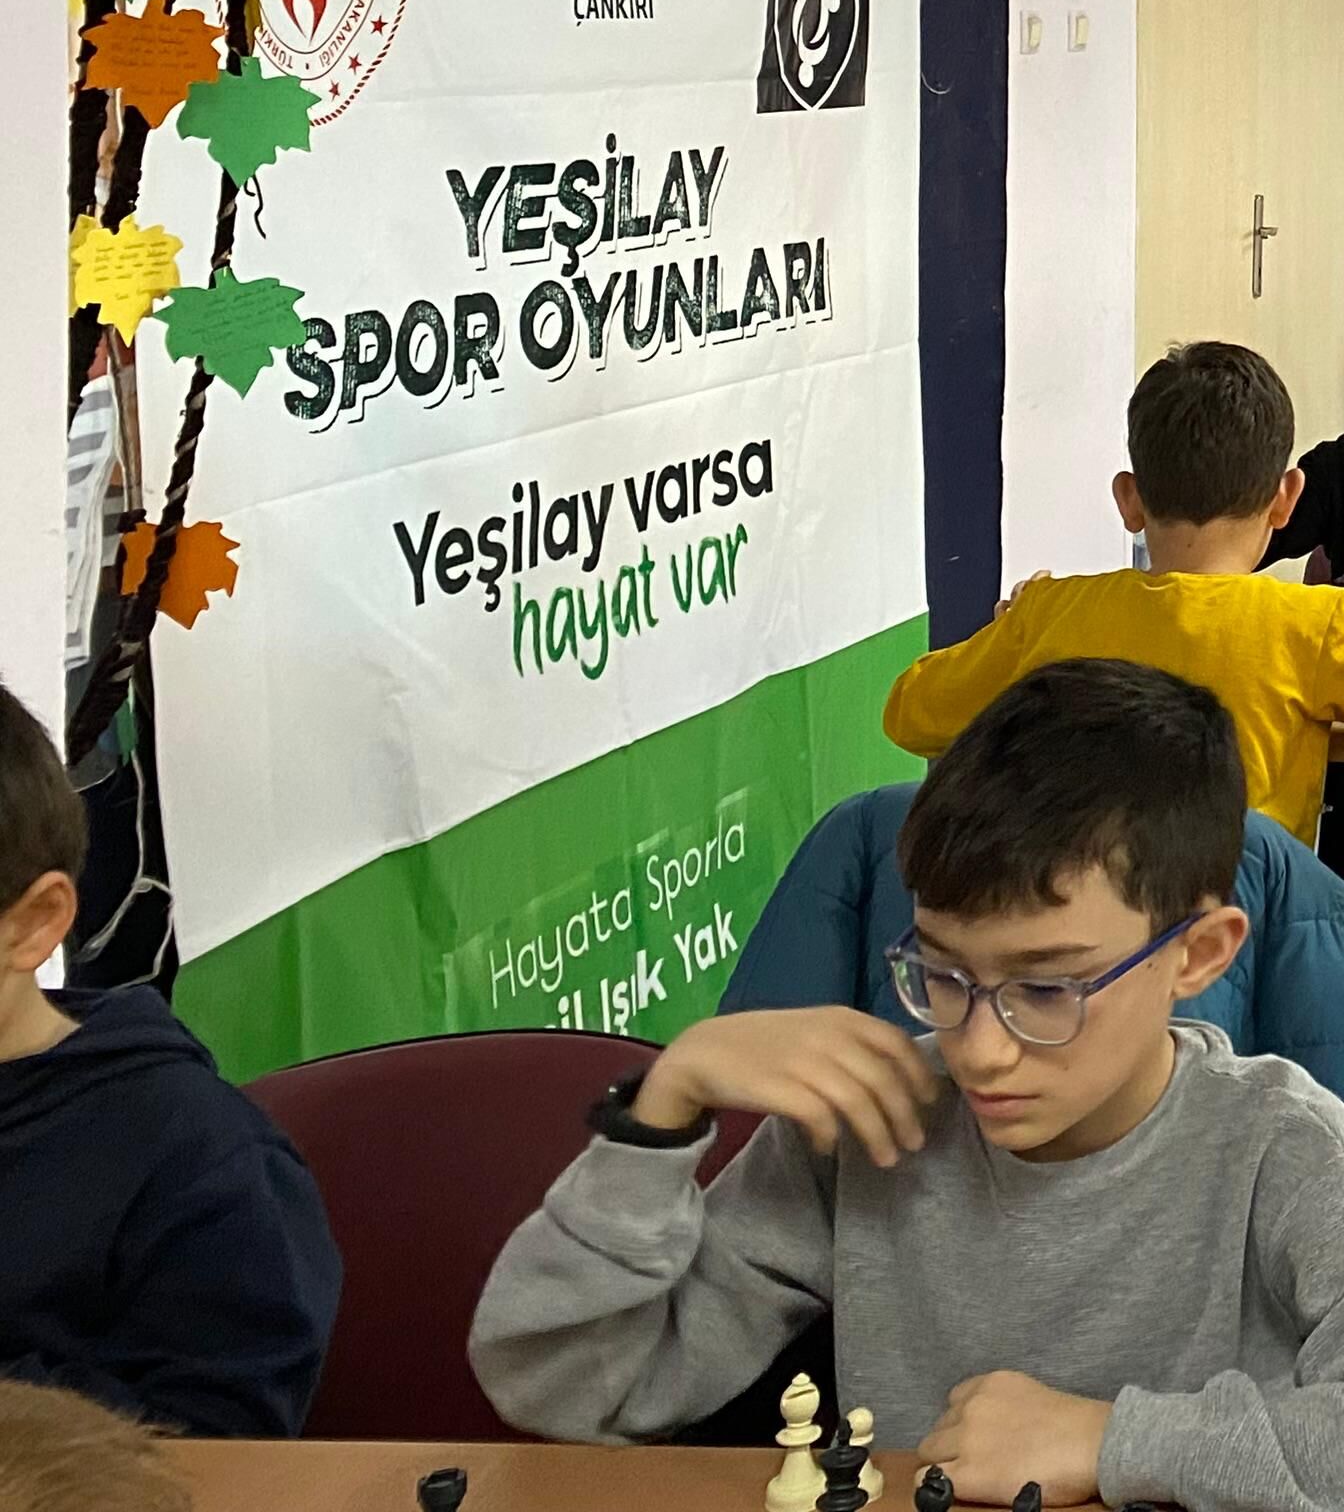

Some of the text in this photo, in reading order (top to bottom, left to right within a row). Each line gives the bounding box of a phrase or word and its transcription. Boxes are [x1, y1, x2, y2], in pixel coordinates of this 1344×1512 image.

[446, 133, 729, 277] YEŞİLAY
[284, 292, 504, 433] SPOR
[519, 238, 832, 381] OYUNLARI
[393, 439, 773, 612] Yeşilay varsa
[512, 523, 748, 680] hayat var
[489, 815, 745, 1009] Hayata Sporla
[600, 949, 667, 1036] Işık
[673, 903, 738, 983] Yak
